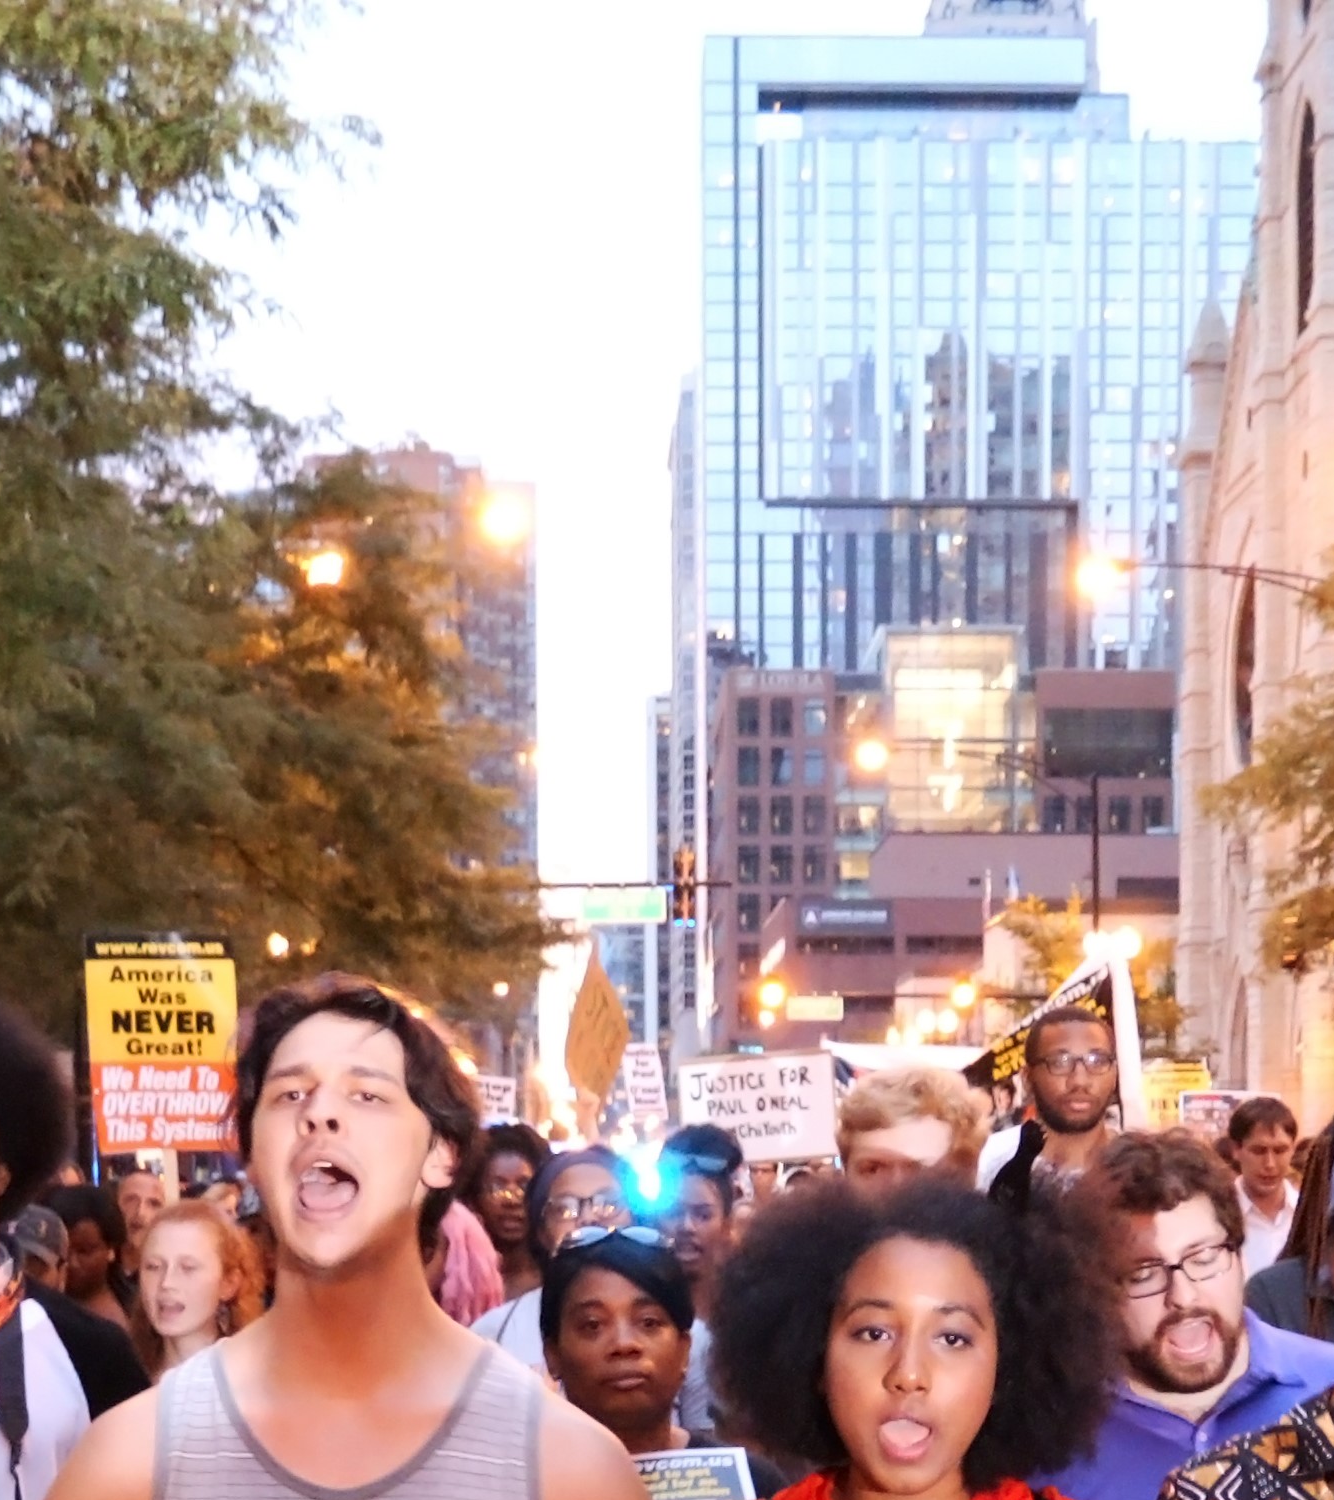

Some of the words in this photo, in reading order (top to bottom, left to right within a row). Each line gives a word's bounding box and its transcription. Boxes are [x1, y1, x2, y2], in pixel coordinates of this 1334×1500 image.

[110, 965, 213, 983] America
[138, 988, 187, 1005] Was
[111, 1010, 215, 1034] NEVER
[126, 1039, 202, 1056] Great!
[101, 1065, 134, 1089] We
[139, 1065, 192, 1090] Need
[197, 1065, 219, 1089] To
[691, 1072, 765, 1100] JUSTICE
[780, 1066, 812, 1086] FOR
[707, 1099, 747, 1116] PAUL
[106, 1118, 147, 1142] This
